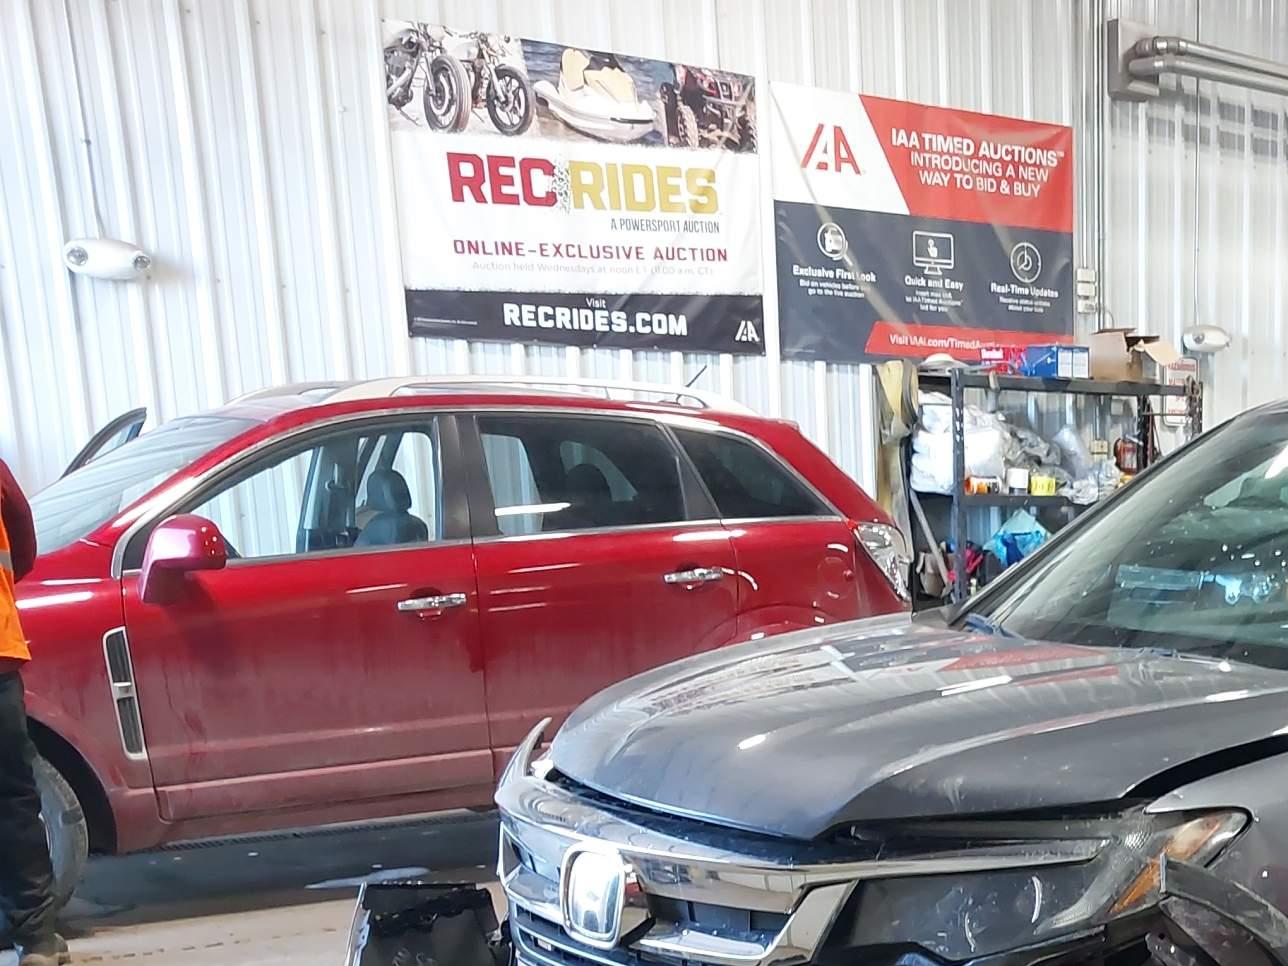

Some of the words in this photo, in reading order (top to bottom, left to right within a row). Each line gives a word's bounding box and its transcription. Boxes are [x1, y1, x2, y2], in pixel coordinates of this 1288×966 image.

[891, 128, 919, 149] IAA
[922, 131, 974, 155] TIMED
[911, 150, 1002, 177] INTRODUCING
[1006, 163, 1016, 177] A
[1019, 164, 1049, 182] NEW
[446, 152, 558, 207] REC
[568, 160, 719, 215] RIDES
[919, 170, 952, 187] WAY
[954, 173, 973, 190] TO
[976, 177, 997, 193] BID
[999, 179, 1010, 194] &
[1013, 181, 1041, 198] BUY
[610, 218, 618, 231] A
[620, 218, 680, 232] POWERSPORT
[683, 221, 720, 234] AUCTION
[453, 239, 645, 260] ONLINE-EXCLUSIVE
[653, 247, 728, 262] AUCTION
[472, 261, 511, 272] Auction
[537, 262, 596, 275] Wednesdays
[793, 265, 834, 278] Exclusive
[836, 269, 855, 281] First
[905, 275, 926, 287] Quick
[928, 278, 943, 288] and
[945, 278, 963, 291] Easy
[991, 281, 1029, 295] Real-Time
[1030, 286, 1058, 298] Updates
[585, 297, 606, 308] Visit
[502, 303, 688, 336] RECRIDES.COM
[889, 334, 909, 346] Visit
